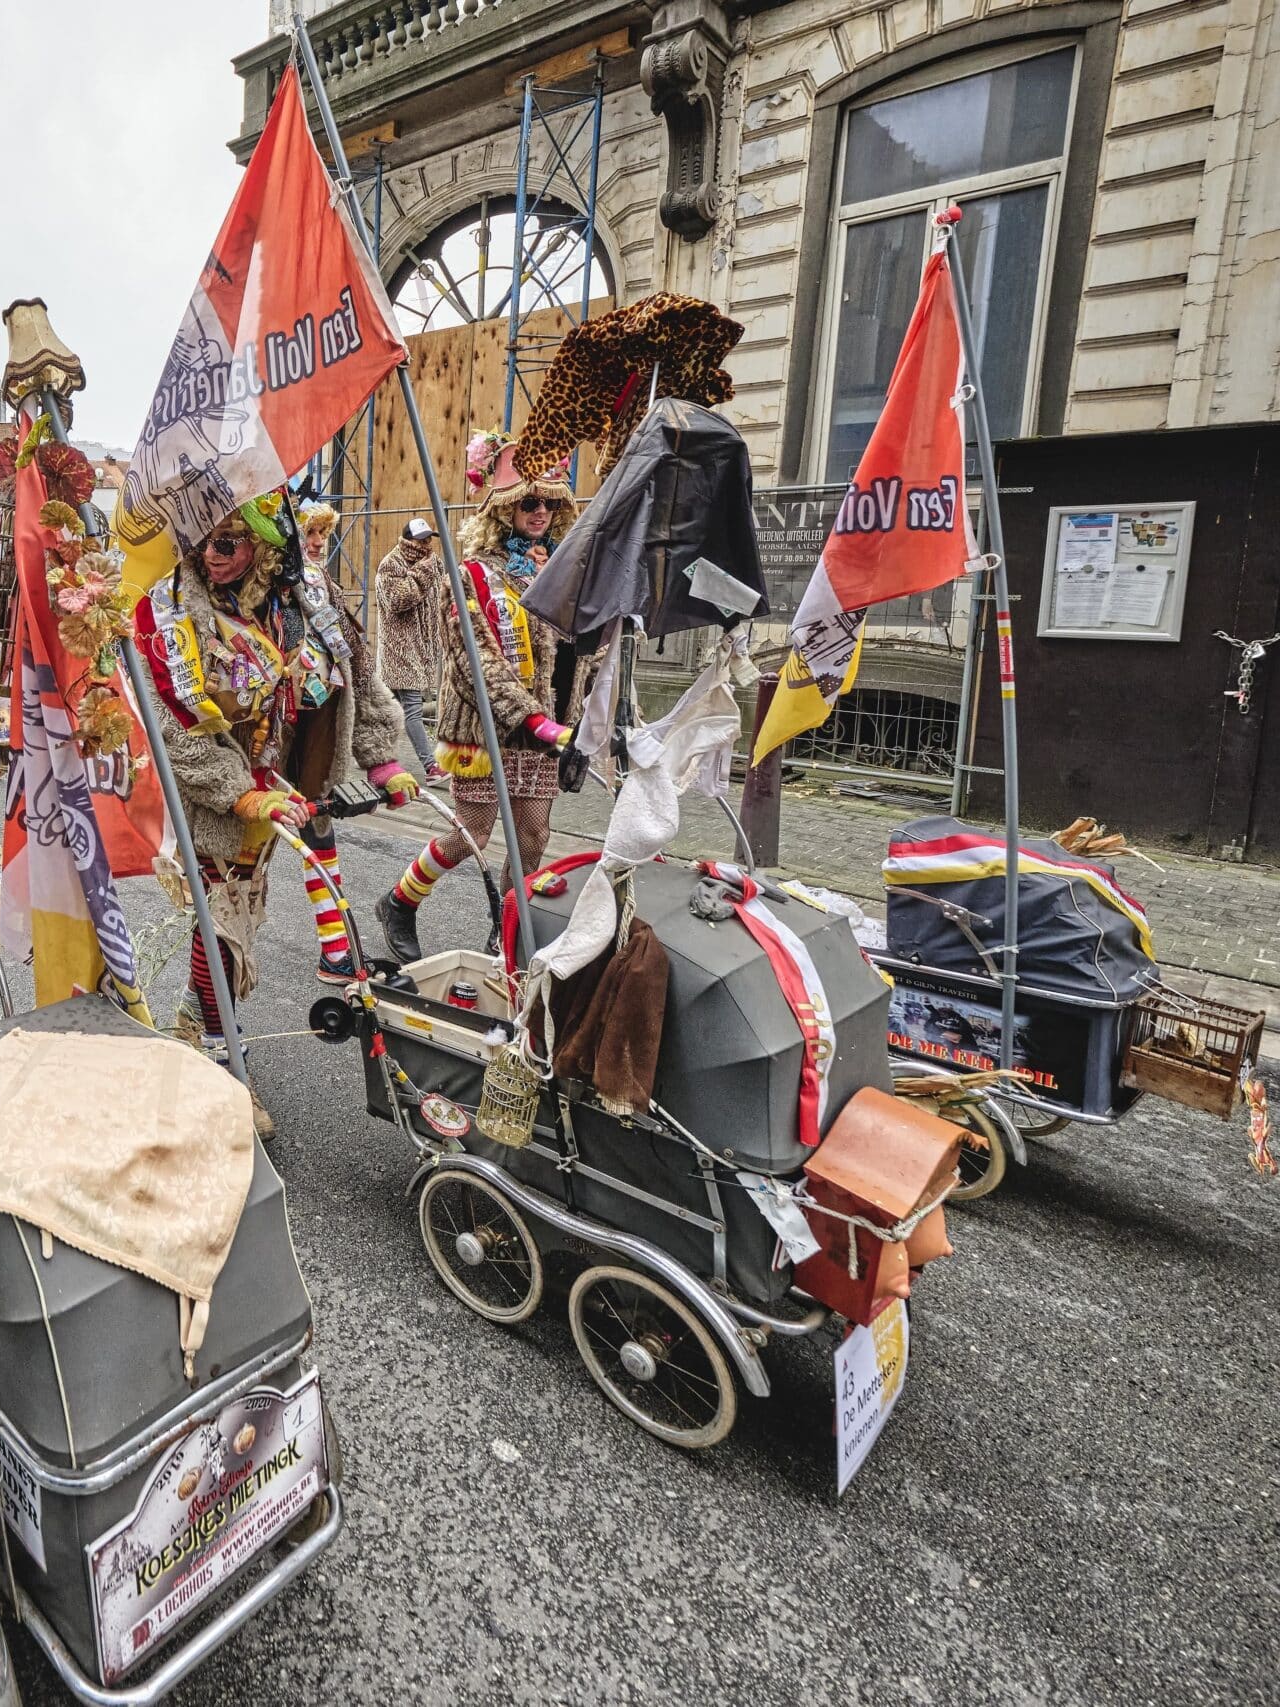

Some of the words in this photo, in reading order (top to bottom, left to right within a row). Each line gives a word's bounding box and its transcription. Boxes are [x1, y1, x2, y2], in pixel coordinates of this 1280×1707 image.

[756, 530, 785, 541] HIEDENIS
[770, 554, 782, 562] TOT
[176, 658, 197, 673] JANET
[938, 984, 978, 1001] TRAVESTIE
[918, 1041, 949, 1060] ME
[1012, 1064, 1058, 1090] OIL
[842, 1371, 855, 1402] 43
[292, 1403, 304, 1429] 1
[843, 1407, 855, 1432] De
[156, 1451, 185, 1491] 2019
[245, 1399, 272, 1411] 2020
[843, 1408, 878, 1462] knienen
[135, 1504, 226, 1596] KOESJKES
[228, 1438, 304, 1515] MIETINGK
[221, 1474, 313, 1561] WWW.OORHUIS.BE
[237, 1533, 263, 1564] GRATIS
[262, 1516, 281, 1538] 0800
